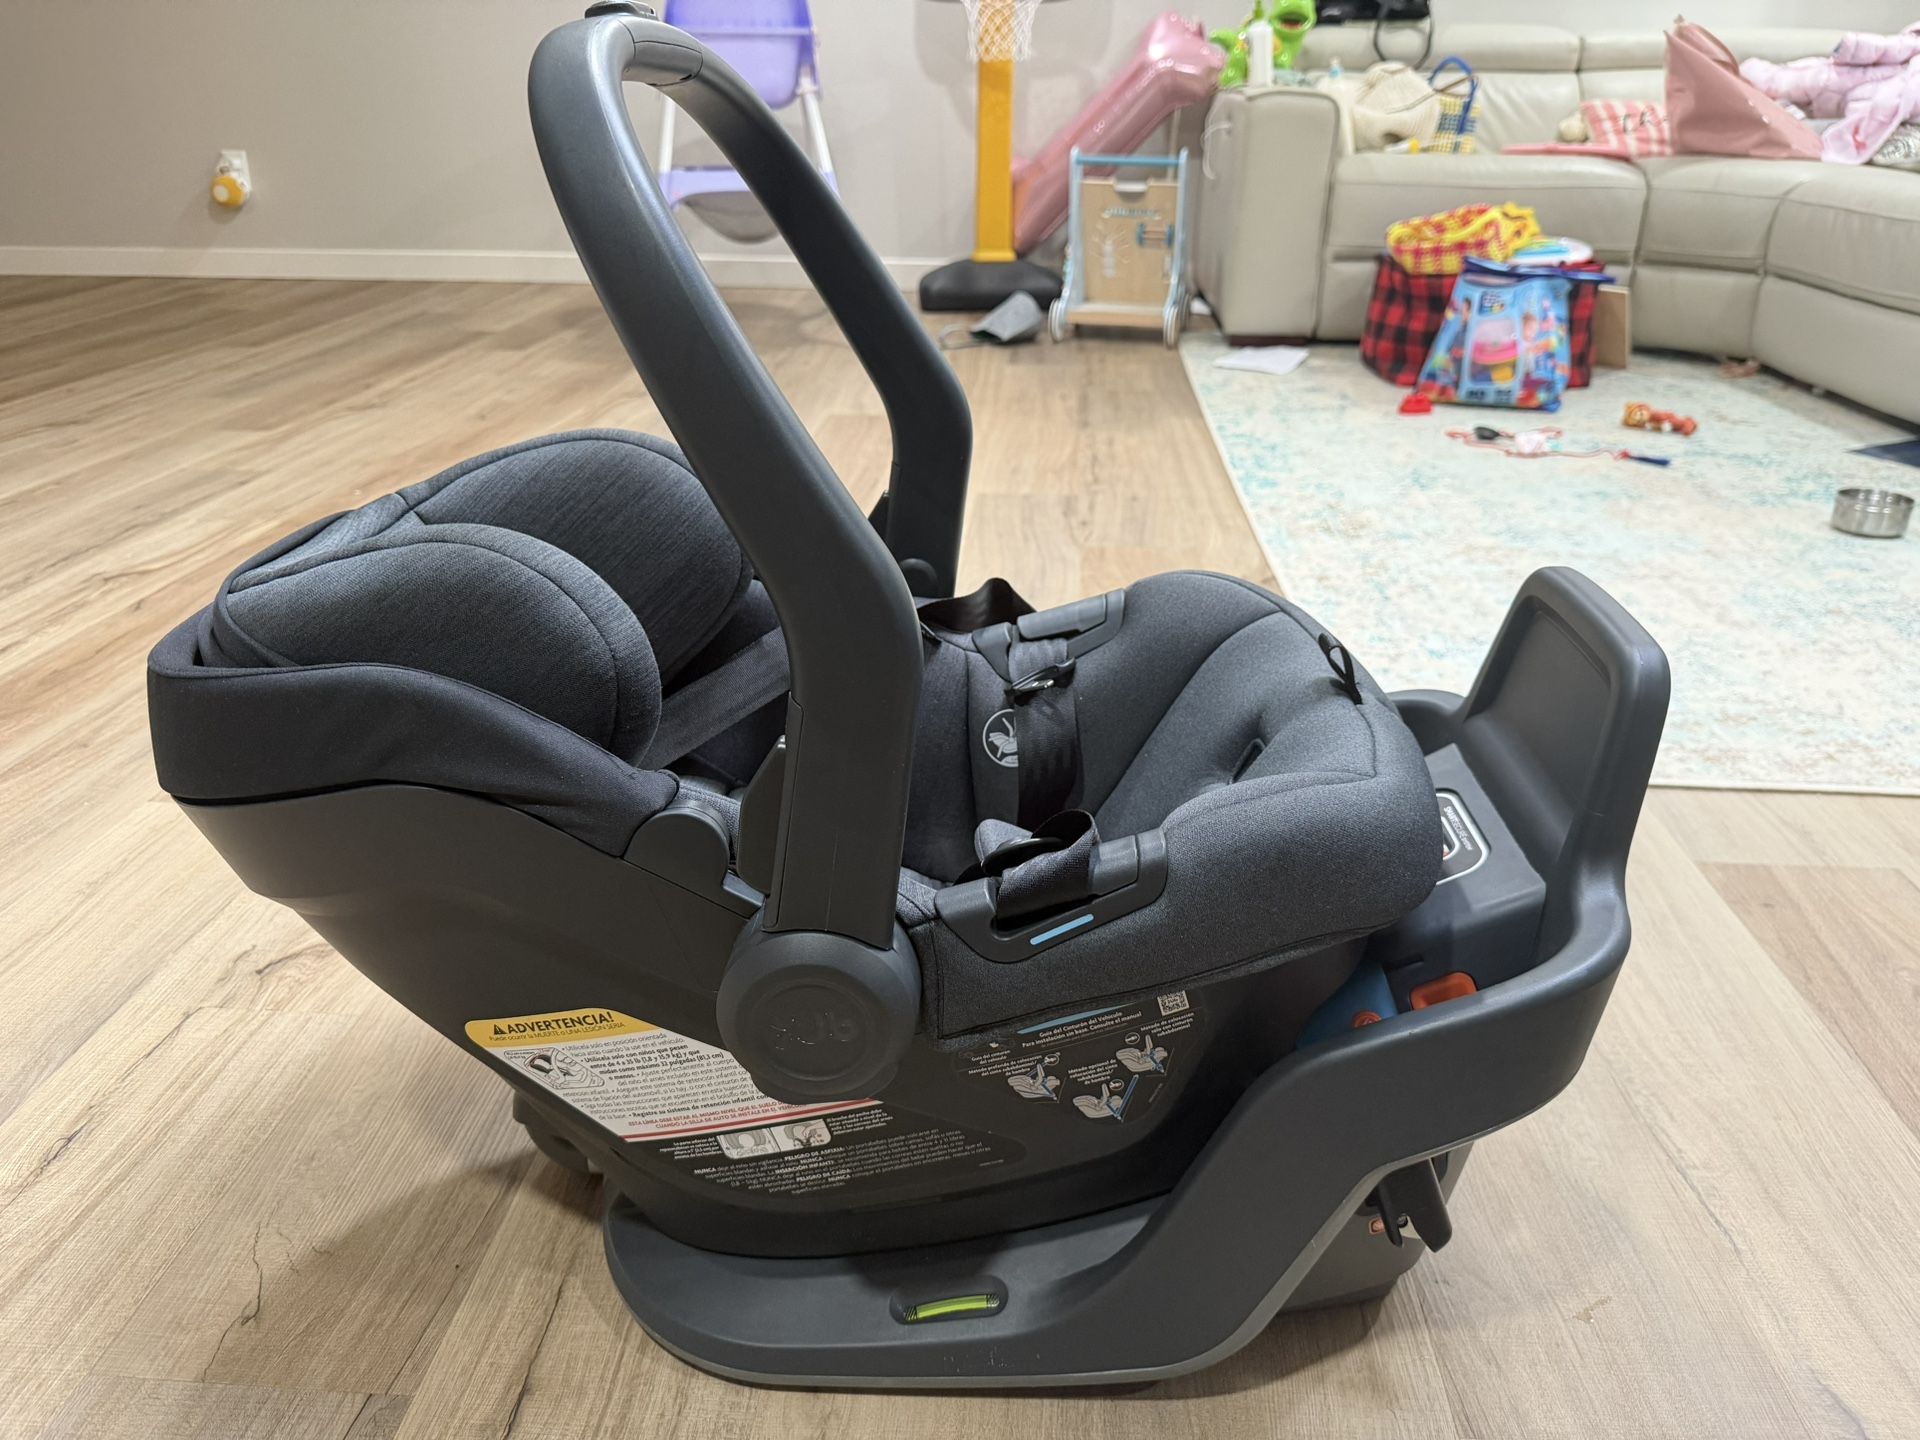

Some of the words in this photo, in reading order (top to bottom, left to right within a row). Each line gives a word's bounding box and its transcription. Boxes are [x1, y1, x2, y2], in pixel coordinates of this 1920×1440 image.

[506, 1011, 614, 1034] ADVERTENCIA!
[533, 1030, 559, 1038] MUERTE
[1021, 1040, 1035, 1048] Para
[1088, 1020, 1113, 1031] Consulte
[1120, 1011, 1142, 1021] manual
[638, 1033, 667, 1041] orientada
[669, 1056, 696, 1066] pulgadas
[711, 1051, 724, 1059] cm)
[670, 1051, 682, 1059] kg)
[641, 1069, 660, 1077] Ajuste
[660, 1063, 705, 1075] perfectamente
[712, 1058, 734, 1066] cuerpo
[714, 1064, 737, 1072] sistema
[666, 1105, 690, 1113] sistema
[731, 1095, 755, 1103] infantil
[693, 1167, 716, 1175] NUNCA
